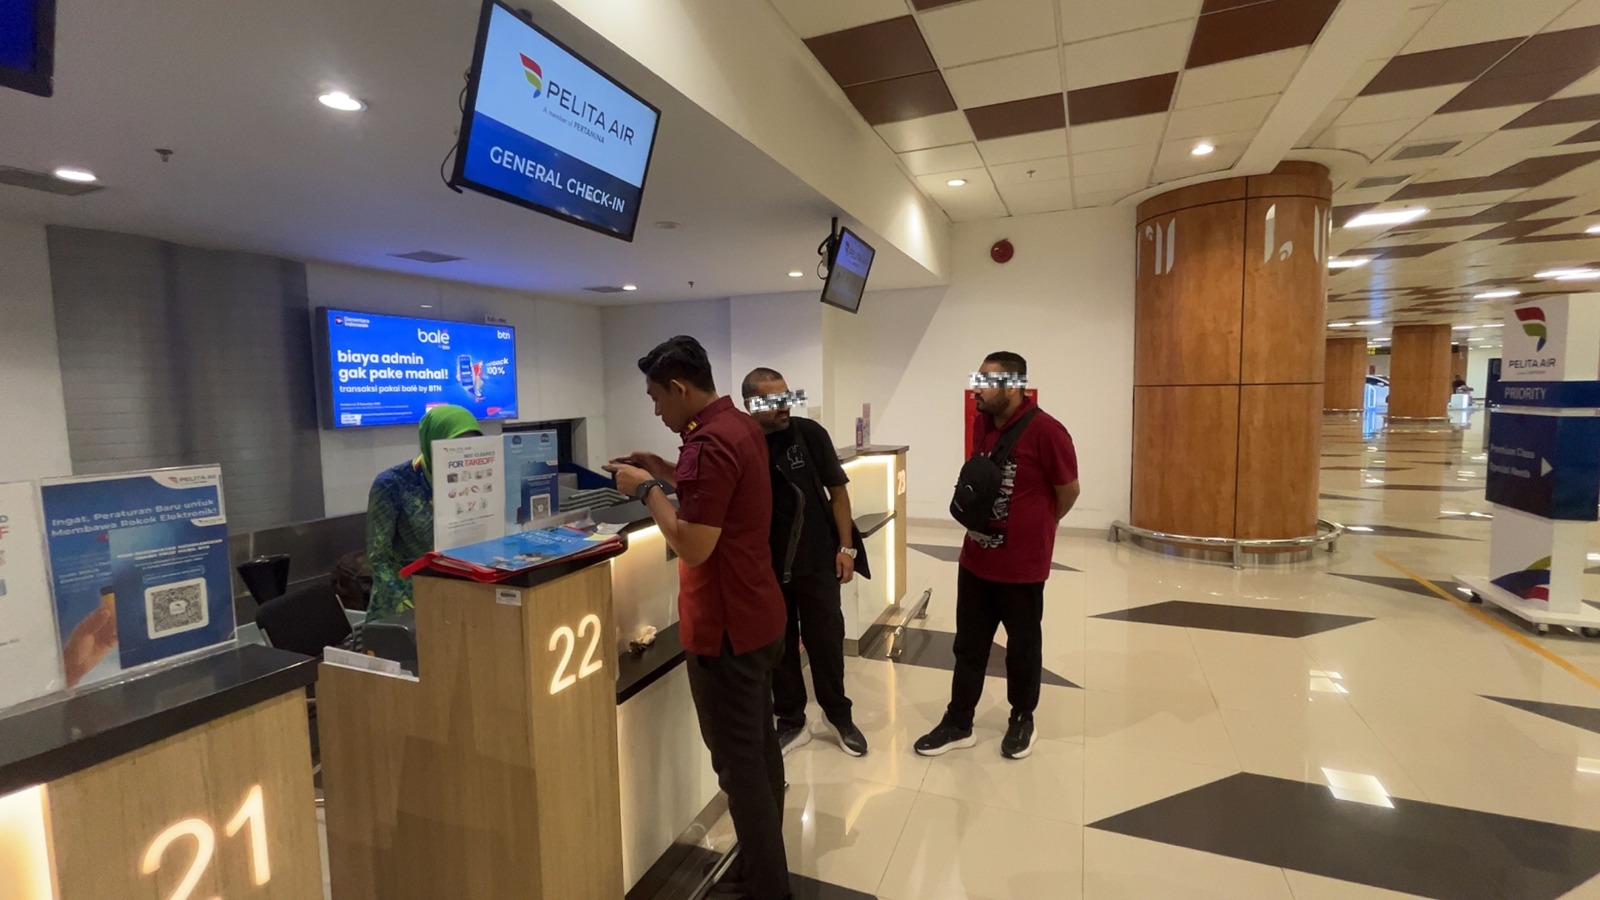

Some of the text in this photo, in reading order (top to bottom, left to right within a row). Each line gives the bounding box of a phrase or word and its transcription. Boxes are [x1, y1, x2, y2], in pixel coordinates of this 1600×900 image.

[547, 80, 635, 146] PELITA AIR
[573, 121, 605, 144] PERTAMINA
[490, 146, 626, 213] GENERAL CHECK-IN
[497, 329, 511, 340] btn
[337, 349, 424, 367] biaya admin
[1508, 357, 1557, 369] PELITA AIR
[338, 366, 449, 383] gak pake mahal!
[339, 384, 378, 393] transaksi
[379, 385, 401, 395] pakai
[418, 385, 428, 395] by
[428, 385, 442, 393] BTN
[1504, 386, 1547, 400] PRIORITY
[448, 456, 496, 469] FOR TAKEOFF
[93, 507, 152, 521] Peraturan
[155, 504, 181, 513] Baru
[183, 498, 214, 509] untuk
[51, 522, 118, 537] Membawa
[120, 516, 157, 528] Rokok
[549, 613, 603, 695] 22
[142, 784, 271, 900] 21
